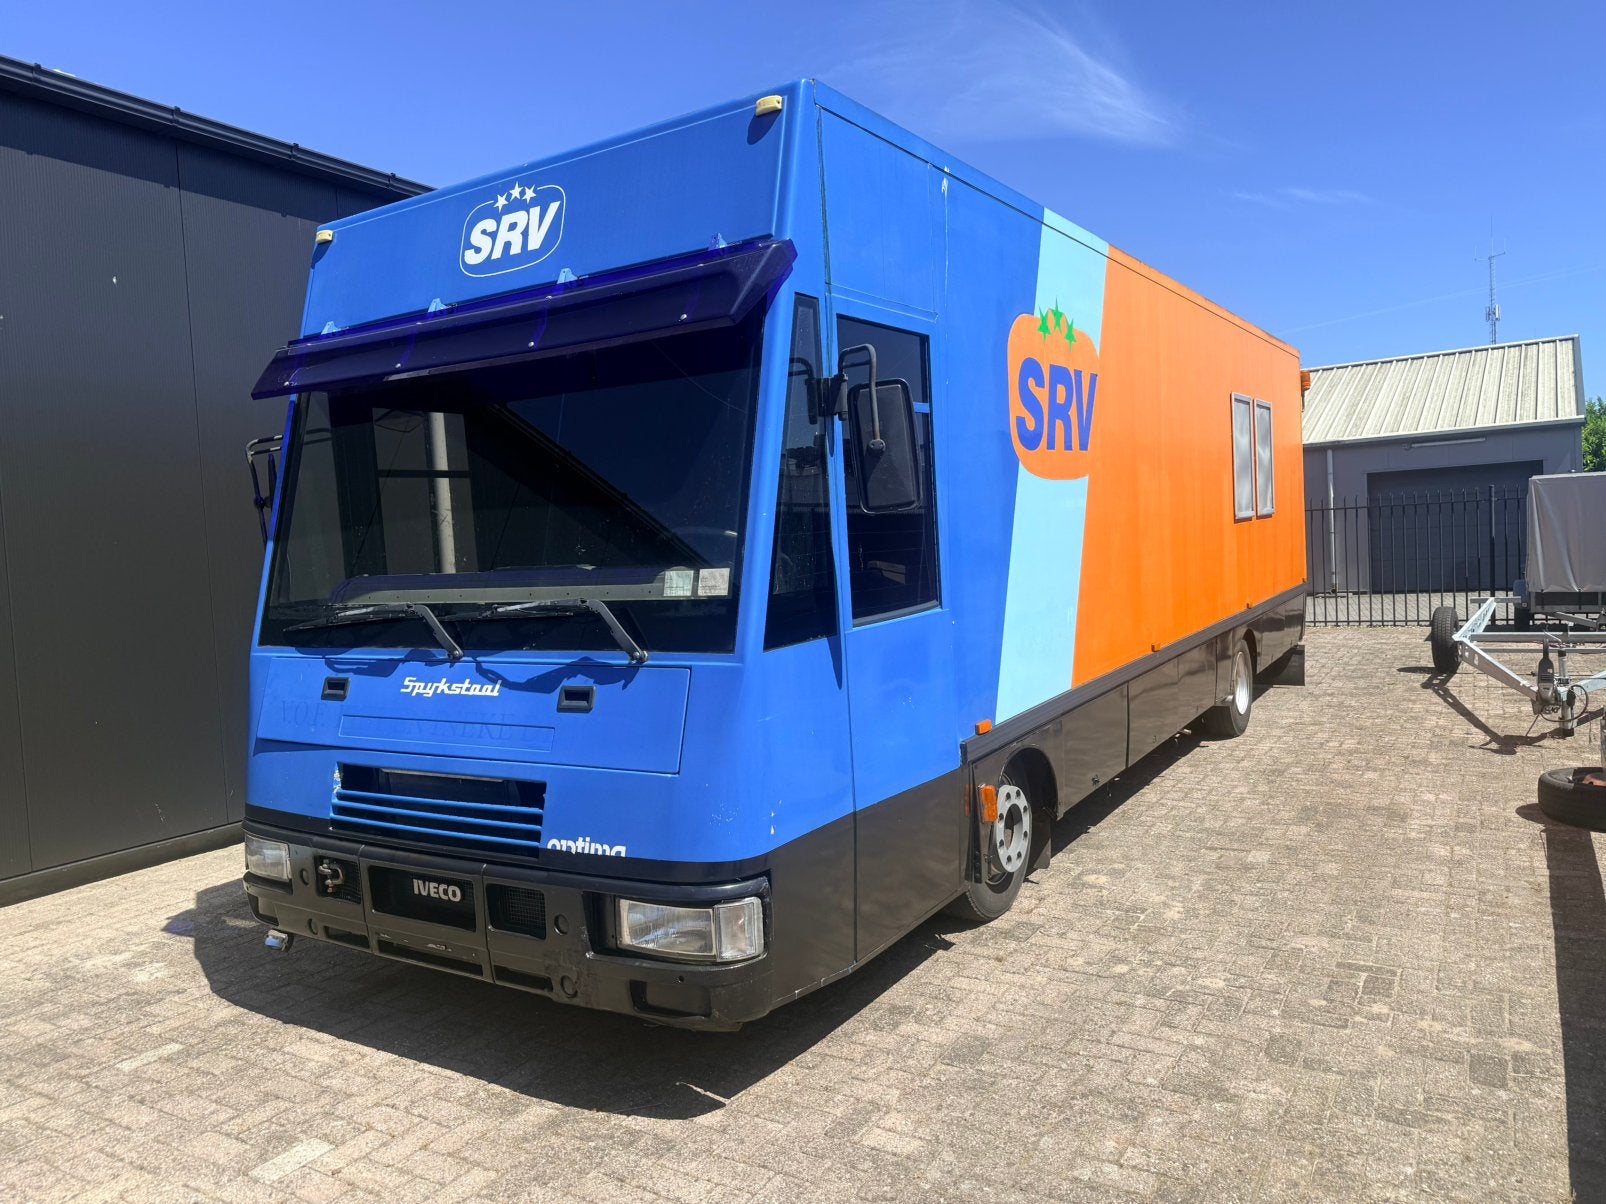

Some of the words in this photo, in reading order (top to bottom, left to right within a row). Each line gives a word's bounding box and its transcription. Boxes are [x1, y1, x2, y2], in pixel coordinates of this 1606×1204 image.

[464, 200, 561, 265] SRV
[1016, 357, 1098, 451] SRV
[401, 677, 502, 697] Spykstaal
[412, 879, 461, 902] IVECO
